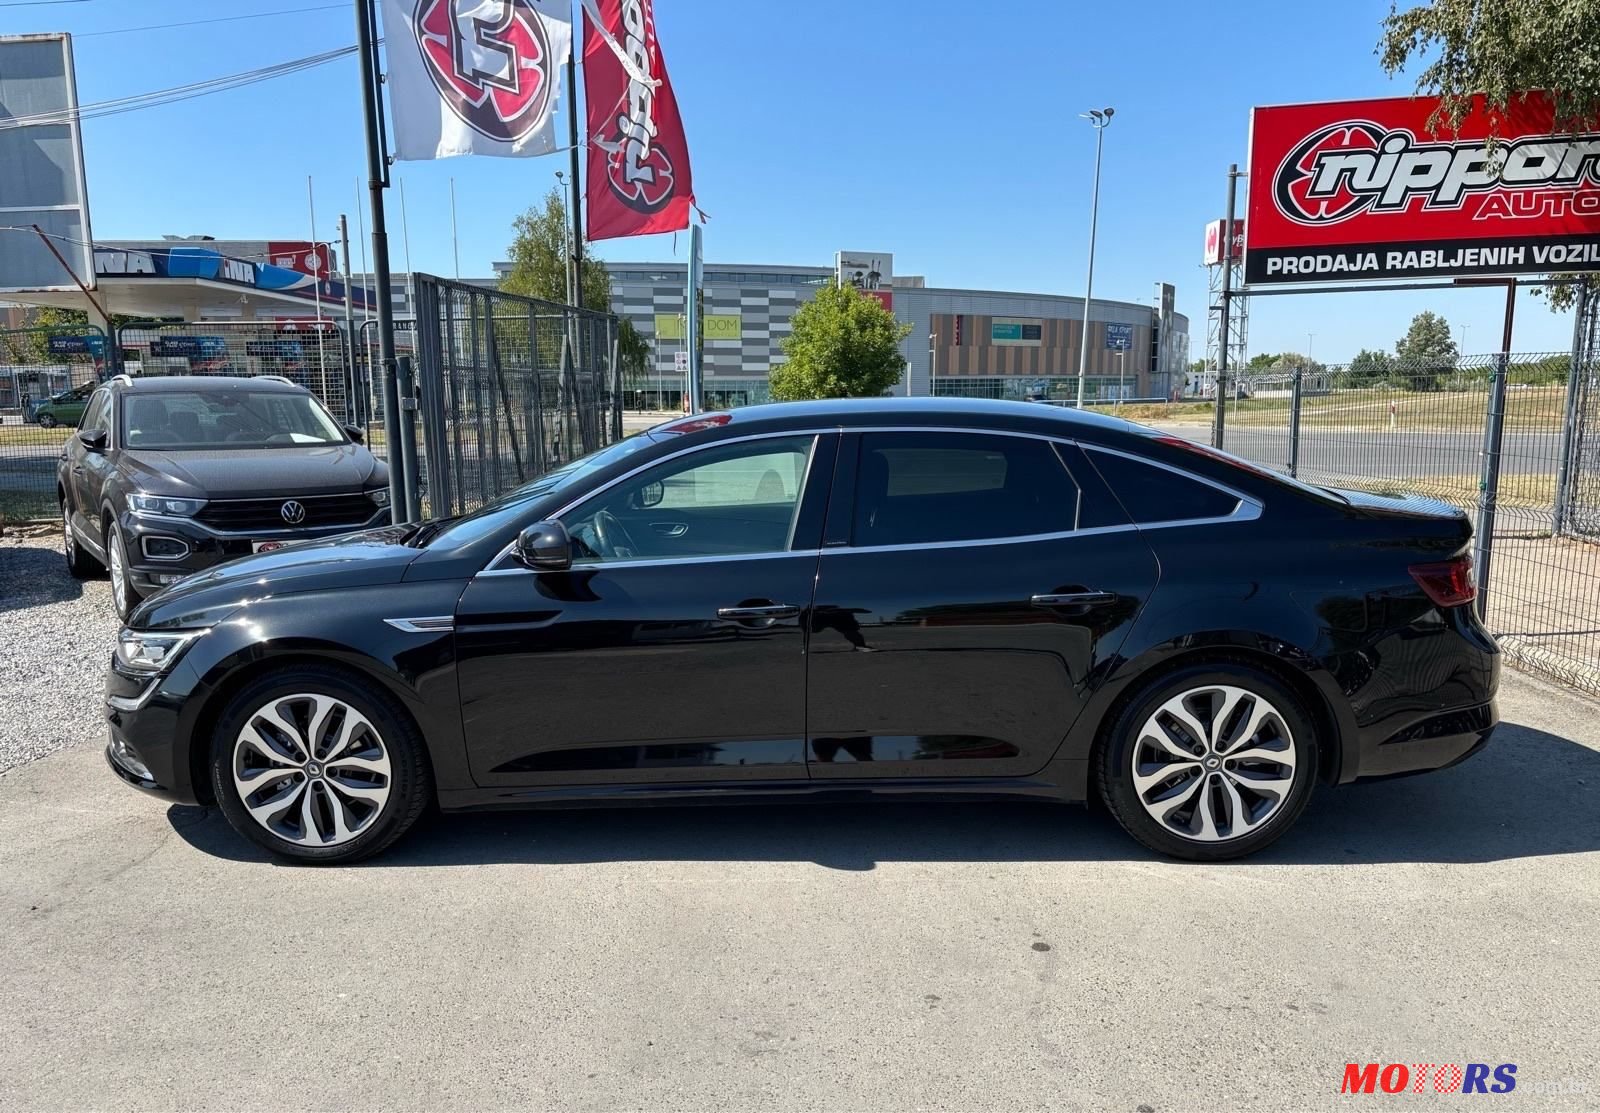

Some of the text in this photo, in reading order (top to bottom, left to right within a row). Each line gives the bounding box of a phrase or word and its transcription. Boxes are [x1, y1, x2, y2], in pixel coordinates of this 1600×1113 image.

[1472, 190, 1600, 220] AUTO
[1266, 243, 1600, 275] PRODAJA RABLJENIH VOZIL
[707, 319, 737, 331] DOM
